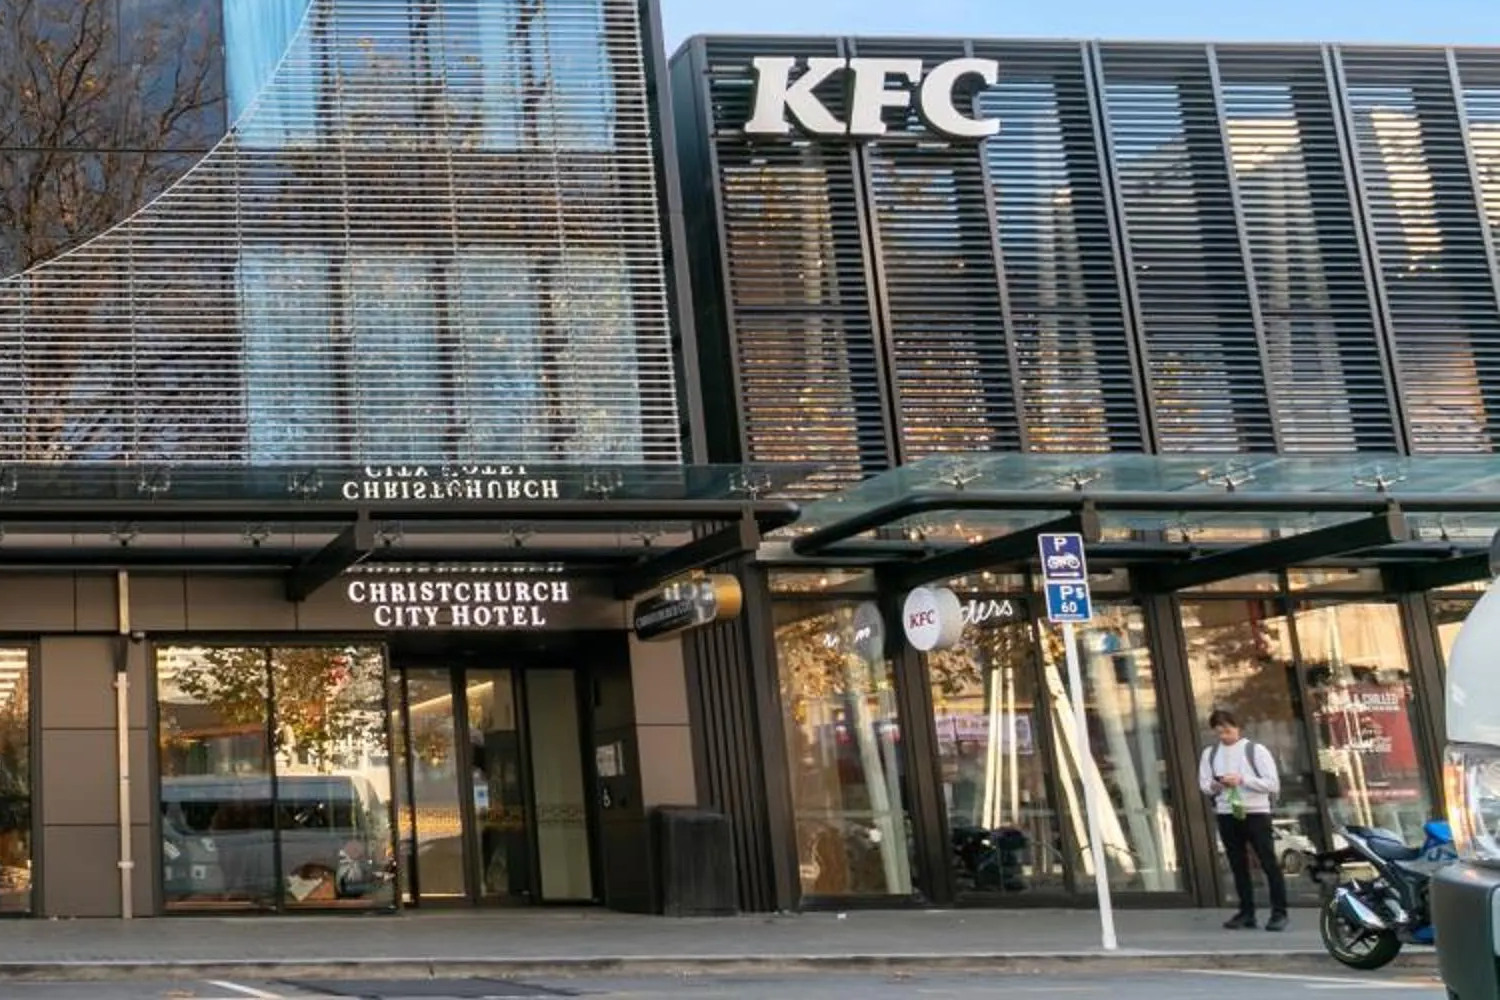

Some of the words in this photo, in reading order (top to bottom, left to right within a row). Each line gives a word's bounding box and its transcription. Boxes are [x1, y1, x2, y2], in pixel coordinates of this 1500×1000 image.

[744, 56, 1001, 137] KFC
[1053, 536, 1067, 552] P
[348, 580, 570, 603] CHRISTCHURCH
[373, 605, 439, 627] CITY
[450, 605, 546, 627] HOTEL
[1061, 601, 1078, 613] 60
[909, 609, 936, 630] KFC
